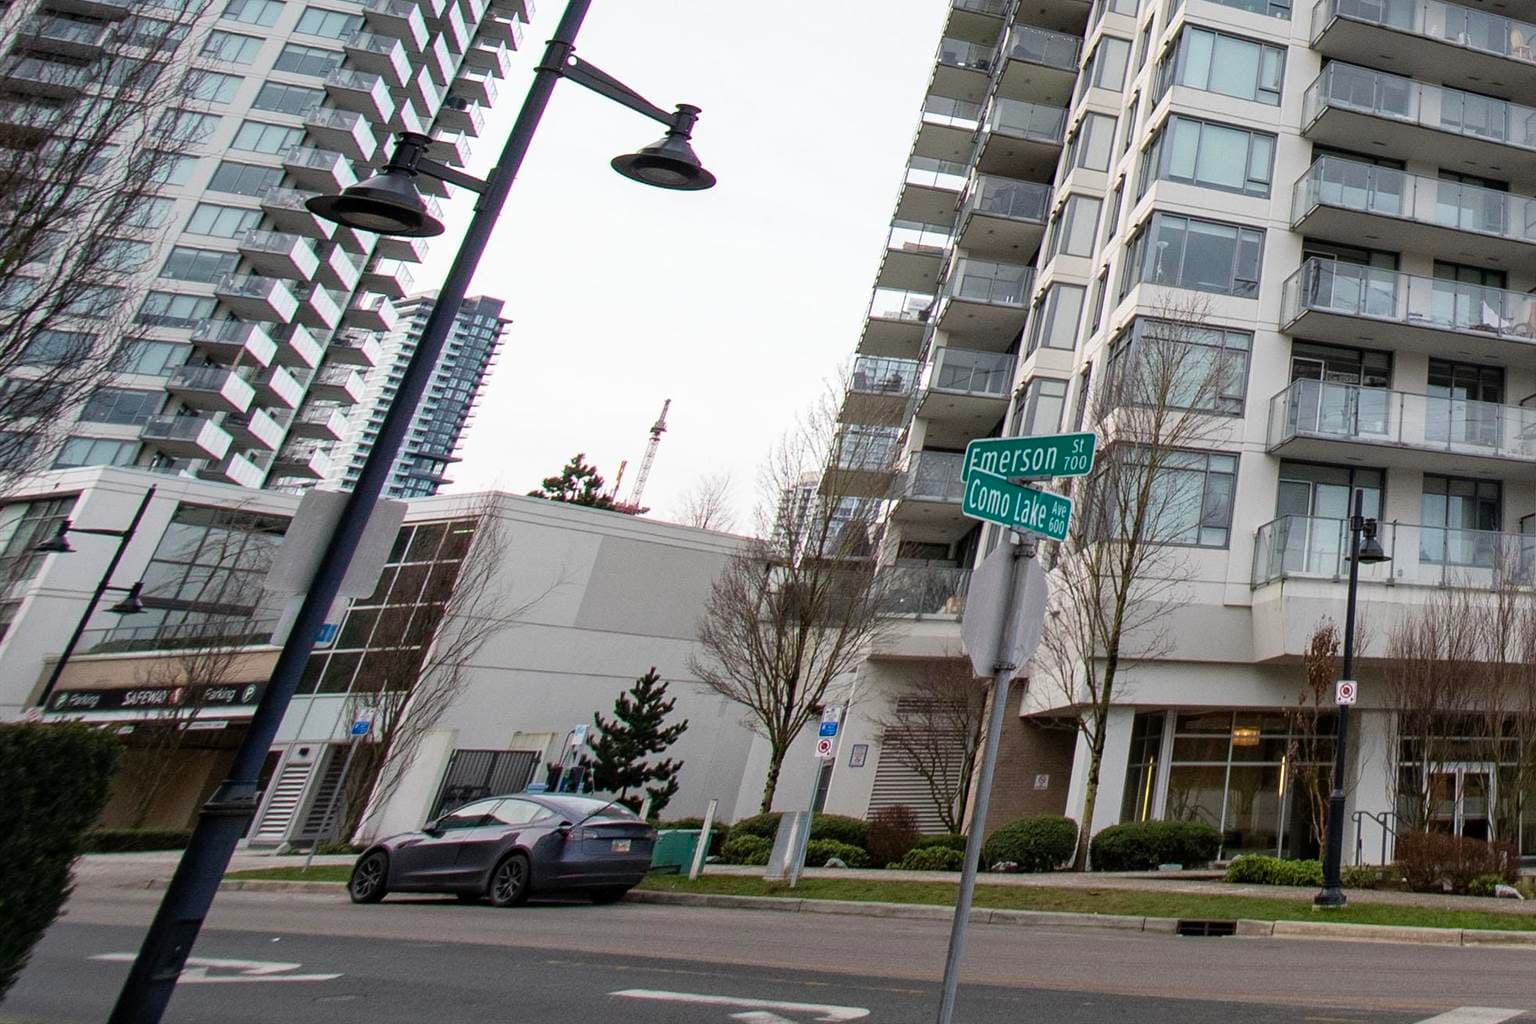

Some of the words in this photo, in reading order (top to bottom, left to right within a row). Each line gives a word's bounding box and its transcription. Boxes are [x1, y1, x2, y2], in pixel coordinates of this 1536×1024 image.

[1071, 438, 1085, 454] St
[969, 446, 1057, 474] Emerson
[1063, 455, 1088, 471] 700
[968, 478, 1011, 518] Como
[1013, 492, 1047, 529] Lake
[1051, 501, 1067, 518] Ave
[1048, 517, 1065, 535] 600
